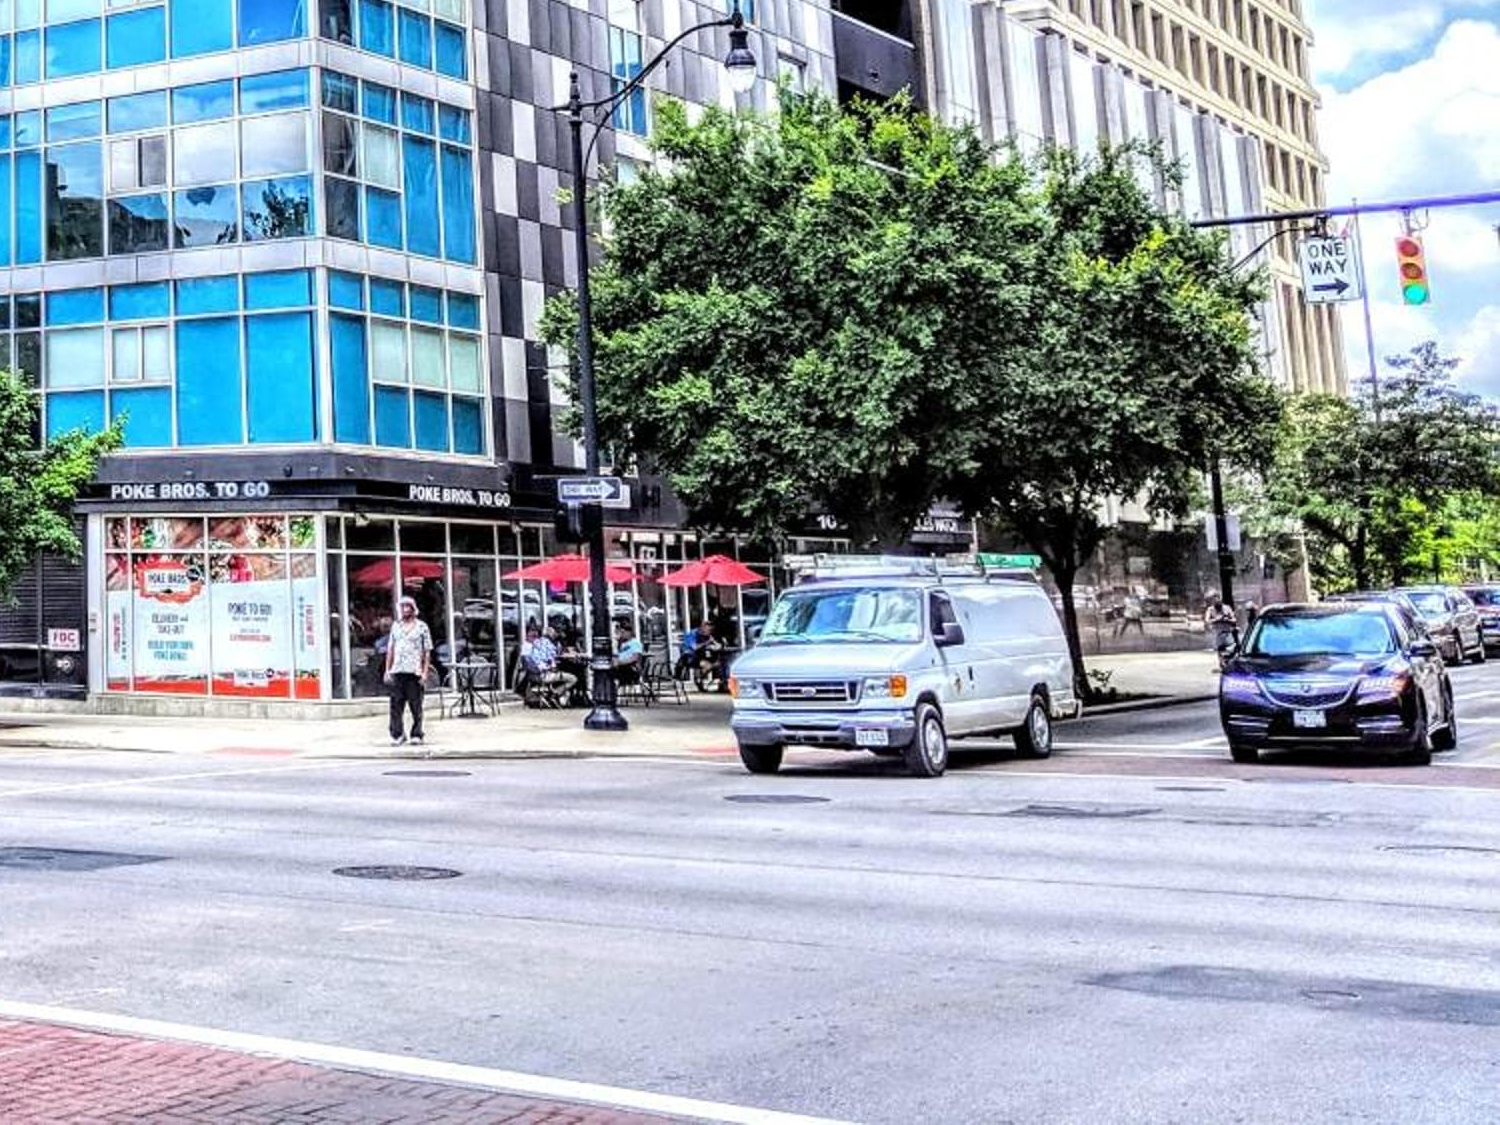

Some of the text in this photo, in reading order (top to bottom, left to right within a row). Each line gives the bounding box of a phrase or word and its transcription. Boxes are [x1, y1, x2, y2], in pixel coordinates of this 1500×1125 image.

[1308, 243, 1345, 258] ONE
[1308, 259, 1347, 275] WAY
[111, 482, 269, 499] POKE BROS. TO GO
[409, 484, 511, 507] POKE BROS. TO GO
[53, 632, 76, 643] FDC
